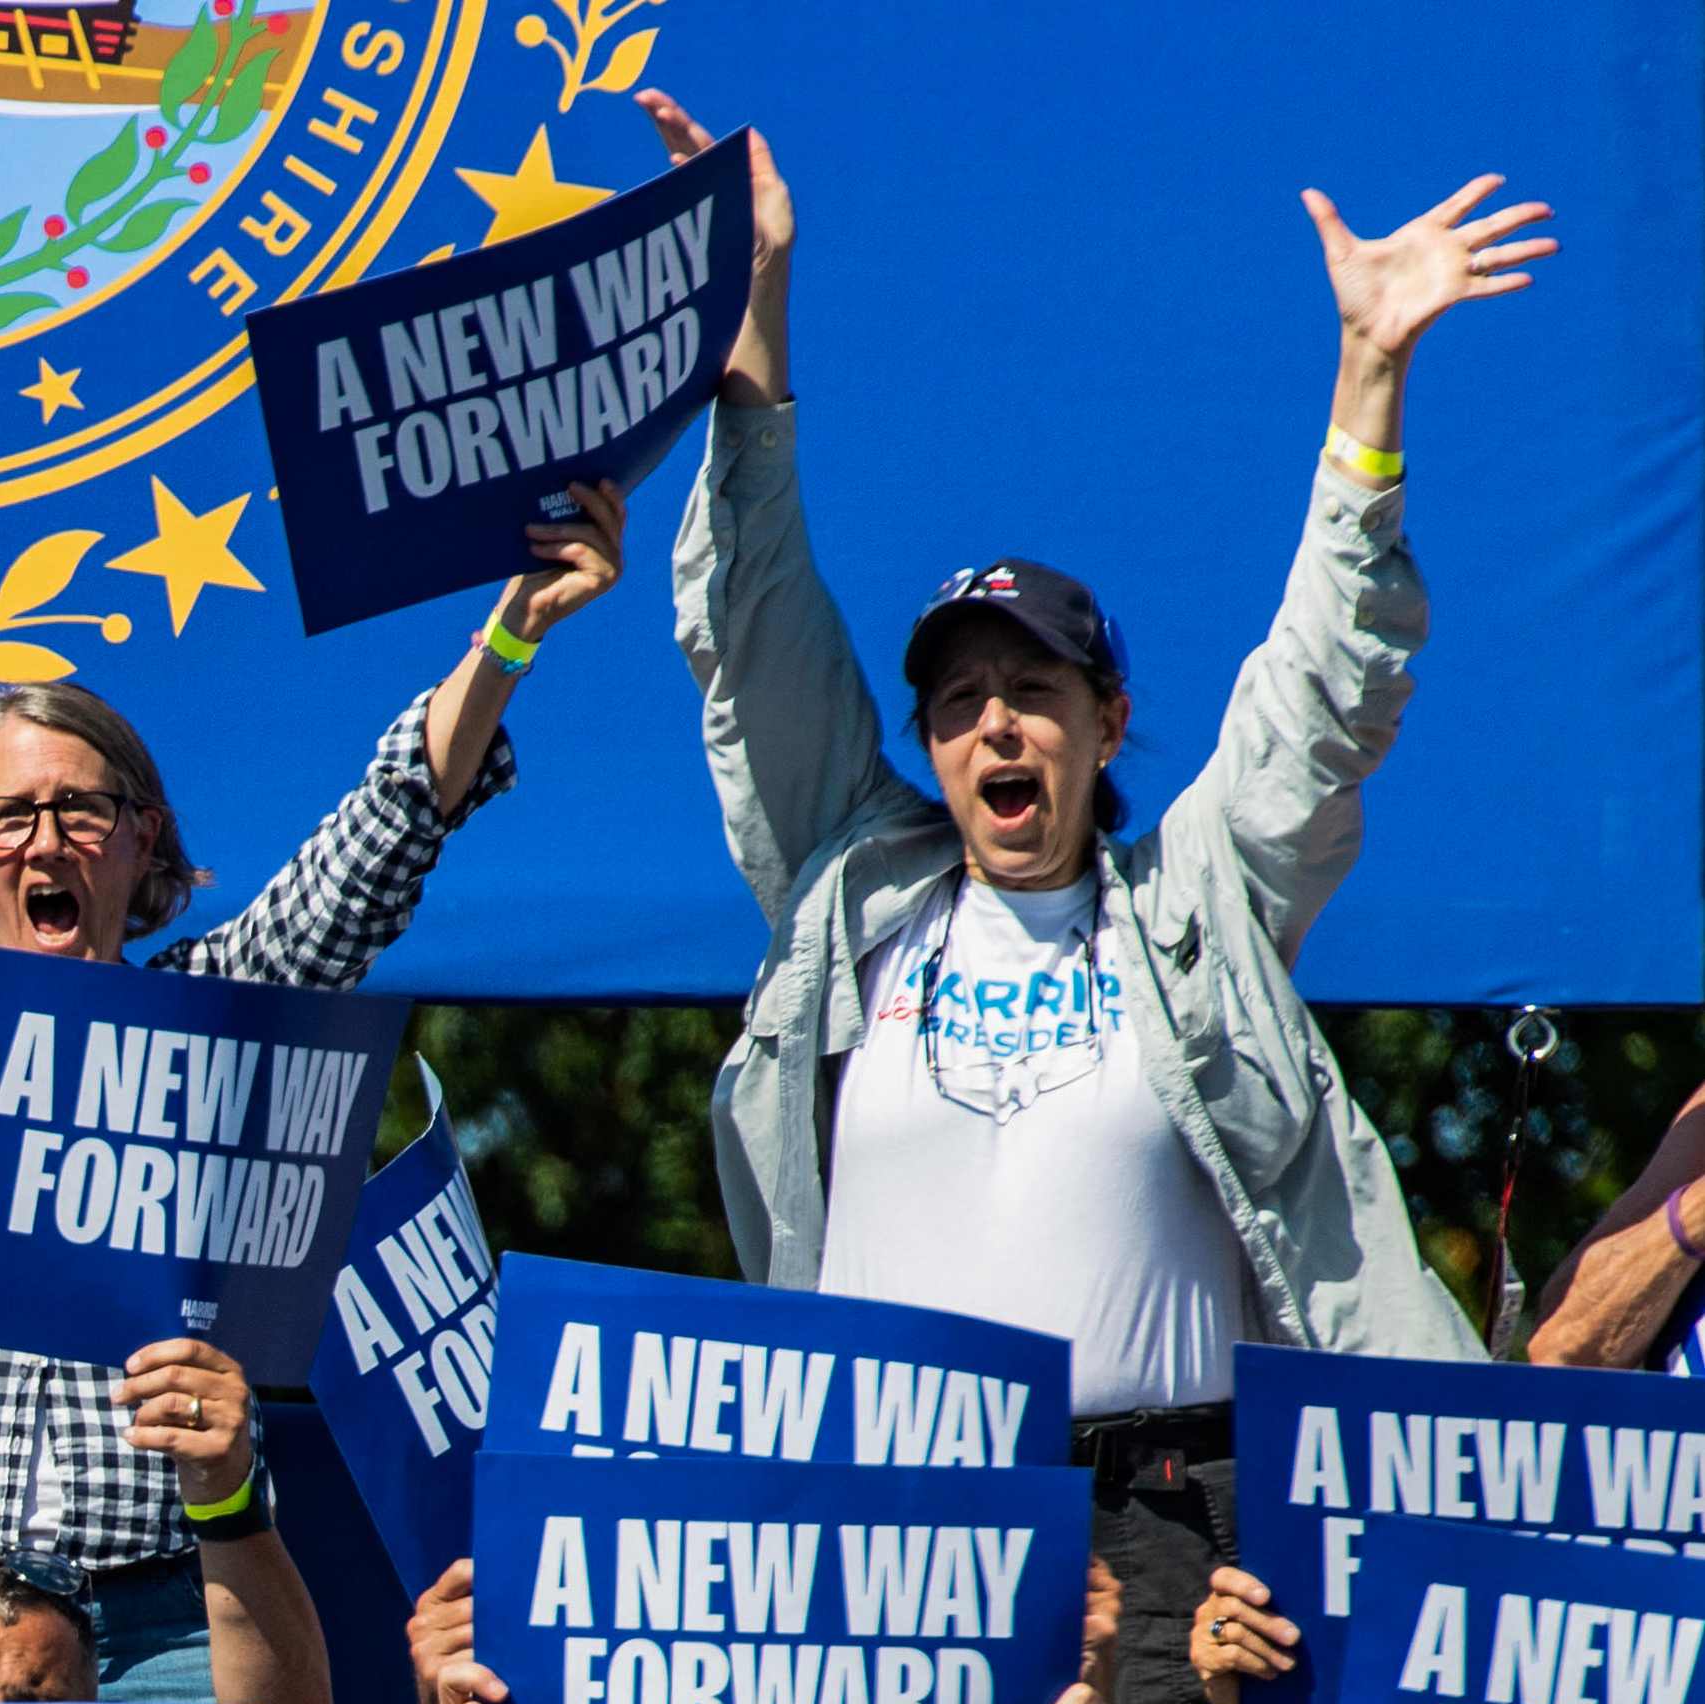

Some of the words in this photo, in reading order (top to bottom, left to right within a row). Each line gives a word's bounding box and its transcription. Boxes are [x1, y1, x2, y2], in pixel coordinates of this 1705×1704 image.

[188, 20, 405, 317] SHIRE
[318, 337, 373, 432] A
[381, 275, 555, 410] NEW
[568, 195, 713, 352] WAY
[353, 306, 700, 514] FORWARD
[73, 1020, 261, 1147] NEW
[266, 1043, 368, 1157] WAY
[7, 1128, 325, 1269] FORWARD
[181, 1298, 218, 1320] HARRIS
[333, 1264, 401, 1375] A
[376, 1171, 490, 1336] NEW
[541, 1321, 601, 1438] A
[622, 1332, 836, 1461] NEW
[853, 1357, 1030, 1468] WAY
[1289, 1405, 1349, 1509] A
[1369, 1410, 1566, 1525] NEW
[1583, 1424, 1705, 1533] WA
[528, 1515, 594, 1629] A
[615, 1519, 822, 1635] NEW
[839, 1523, 1034, 1640] WAY
[1398, 1582, 1467, 1698] A
